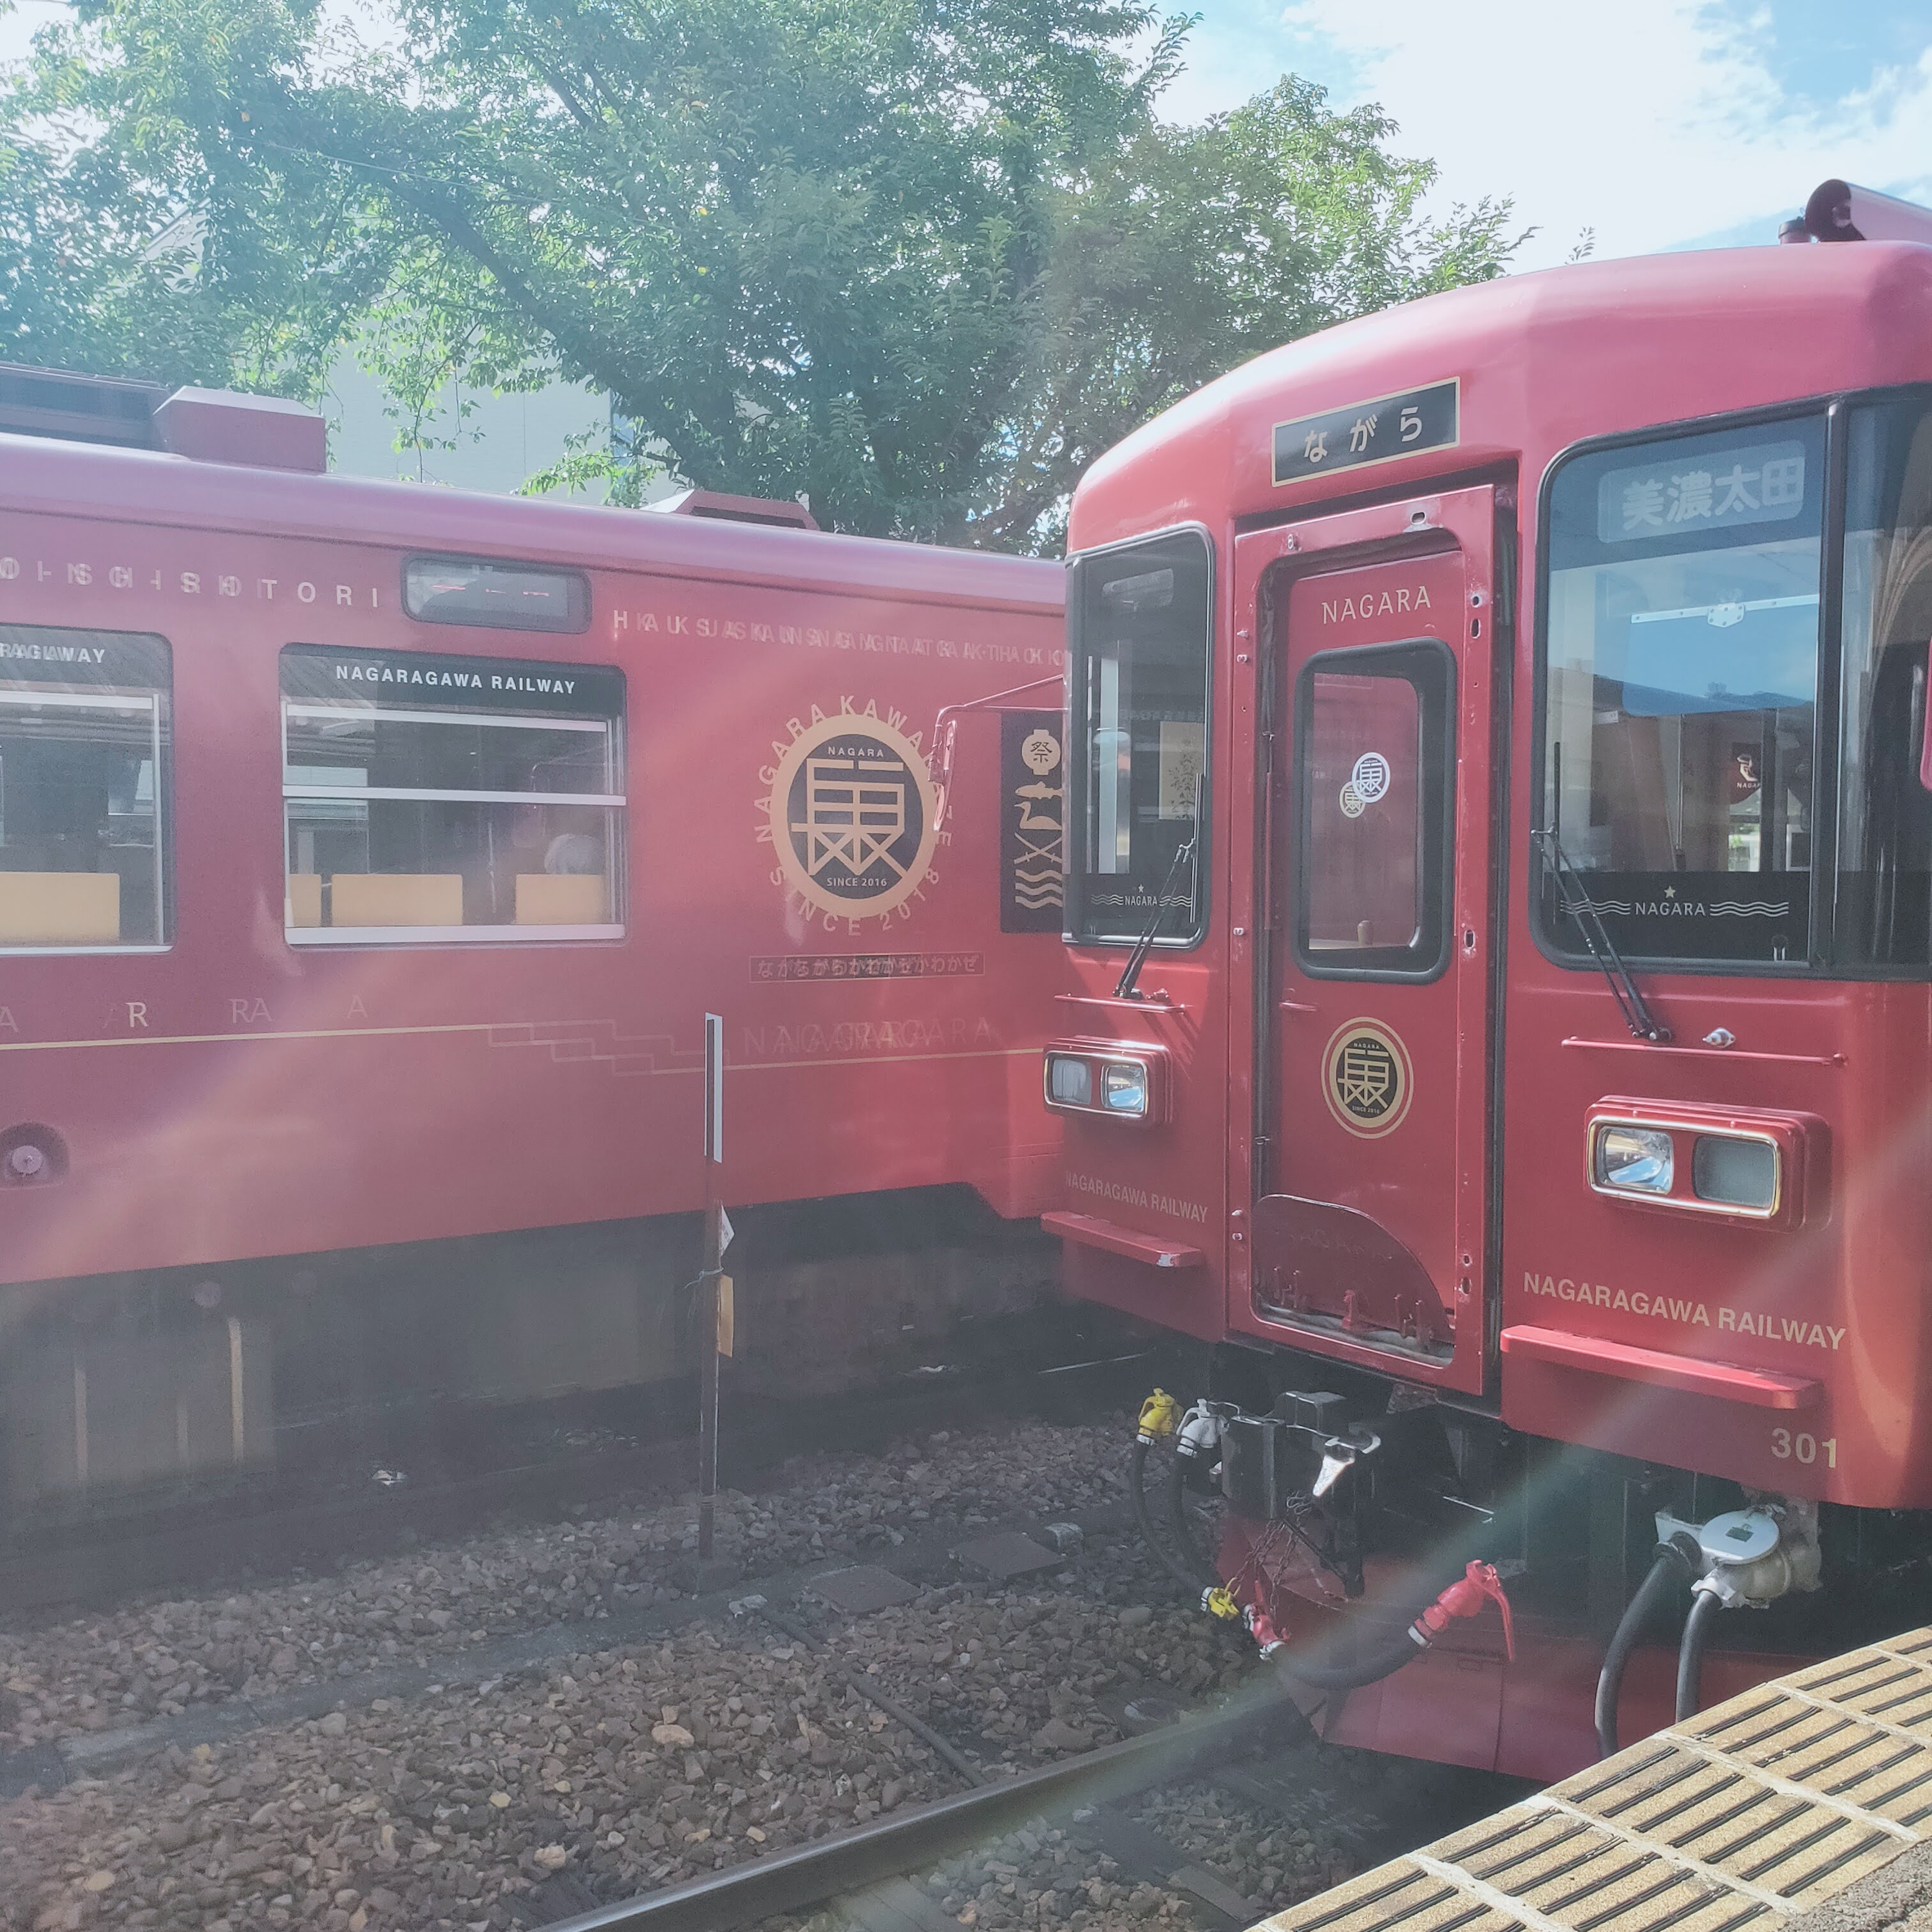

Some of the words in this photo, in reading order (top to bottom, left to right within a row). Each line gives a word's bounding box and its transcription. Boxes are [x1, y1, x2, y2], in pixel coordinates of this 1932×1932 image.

[1304, 406, 1422, 463] ながら
[1622, 456, 1804, 531] 美濃太田
[1321, 586, 1431, 624] NAGARA
[336, 665, 482, 688] NAGARAGAWA
[491, 676, 575, 694] RAILWAY
[828, 746, 884, 757] NAGARA
[1030, 741, 1052, 764] 祭
[827, 876, 858, 887] SINCE
[861, 878, 887, 887] 2016
[1124, 895, 1158, 907] NAGARA
[1635, 902, 1706, 916] NAGARA
[1066, 1170, 1148, 1208] NAGARAGAWA
[1151, 1193, 1208, 1223] RAILWAY
[1524, 1272, 1710, 1327] NAGARAGAWA
[1718, 1307, 1846, 1350] RAILWAY
[1771, 1428, 1837, 1469] 301
